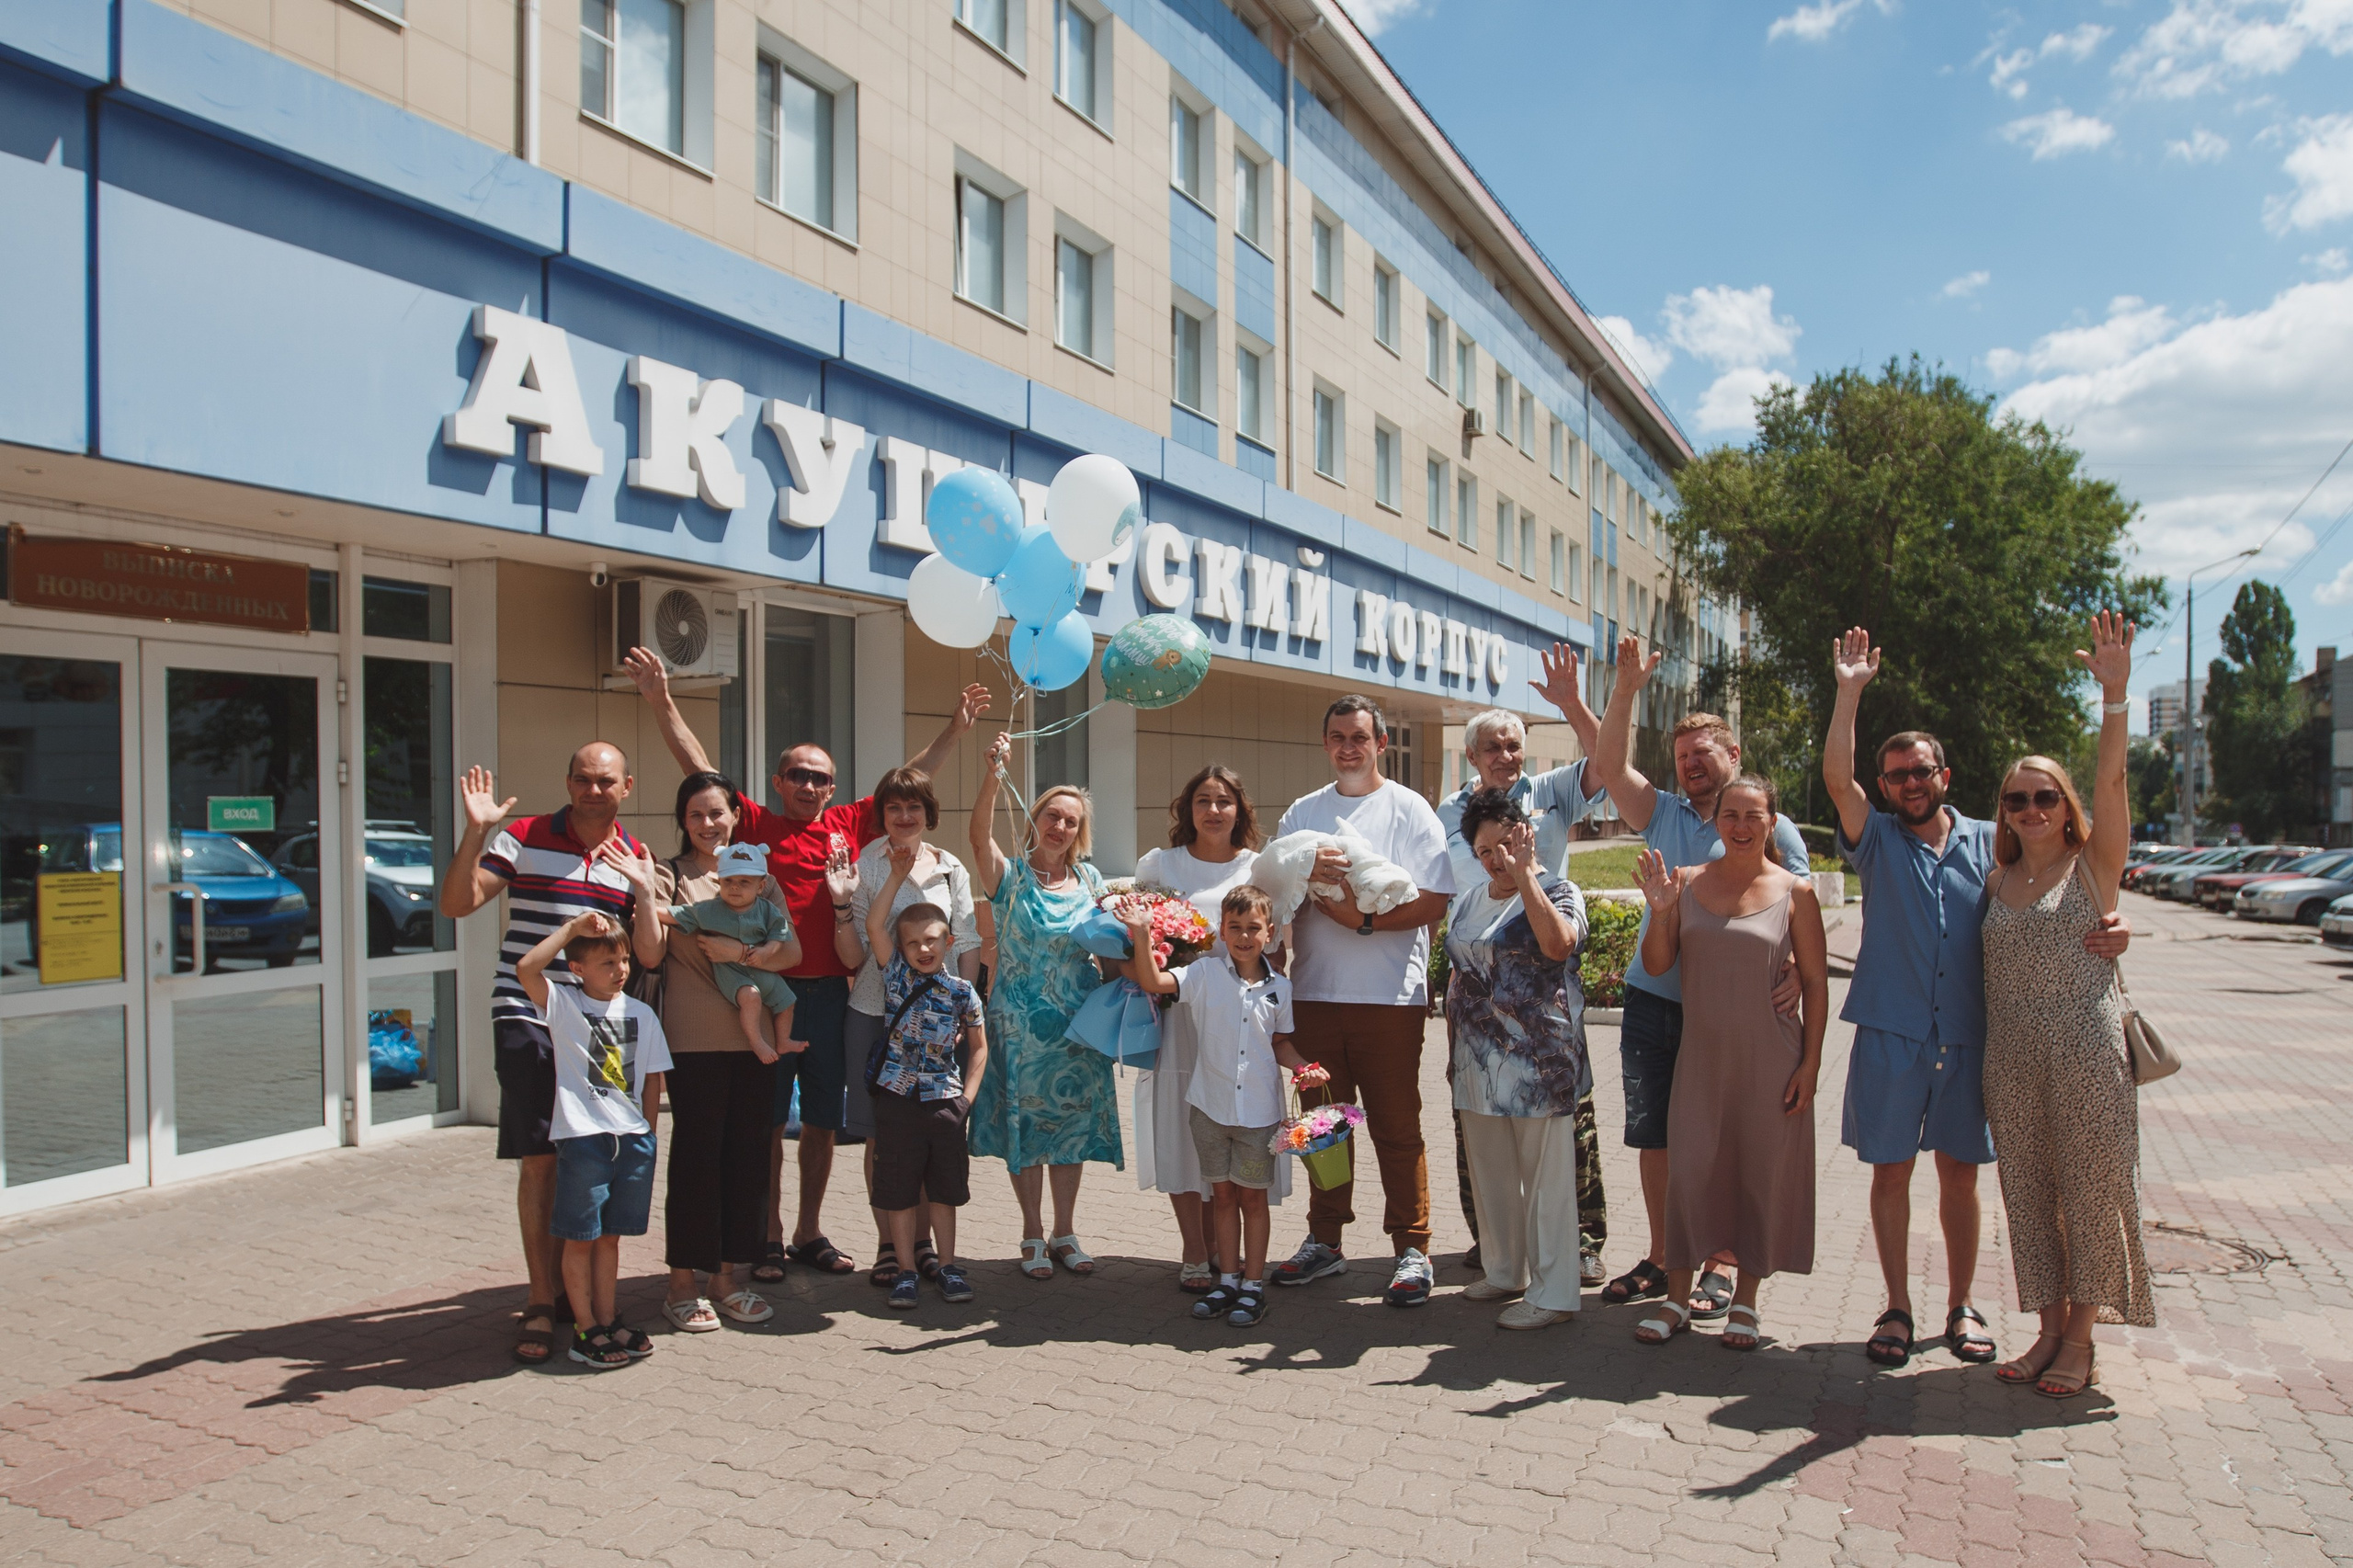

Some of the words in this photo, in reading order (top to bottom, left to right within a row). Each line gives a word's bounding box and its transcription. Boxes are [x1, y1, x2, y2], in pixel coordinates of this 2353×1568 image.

[443, 304, 1330, 642] АКУСКИЙ
[1356, 589, 1508, 684] КОРПУС
[104, 551, 234, 584] ВЫПИСКА
[37, 574, 289, 620] НОВОРОЖДЕННЫХ
[224, 808, 258, 820] ВХОД
